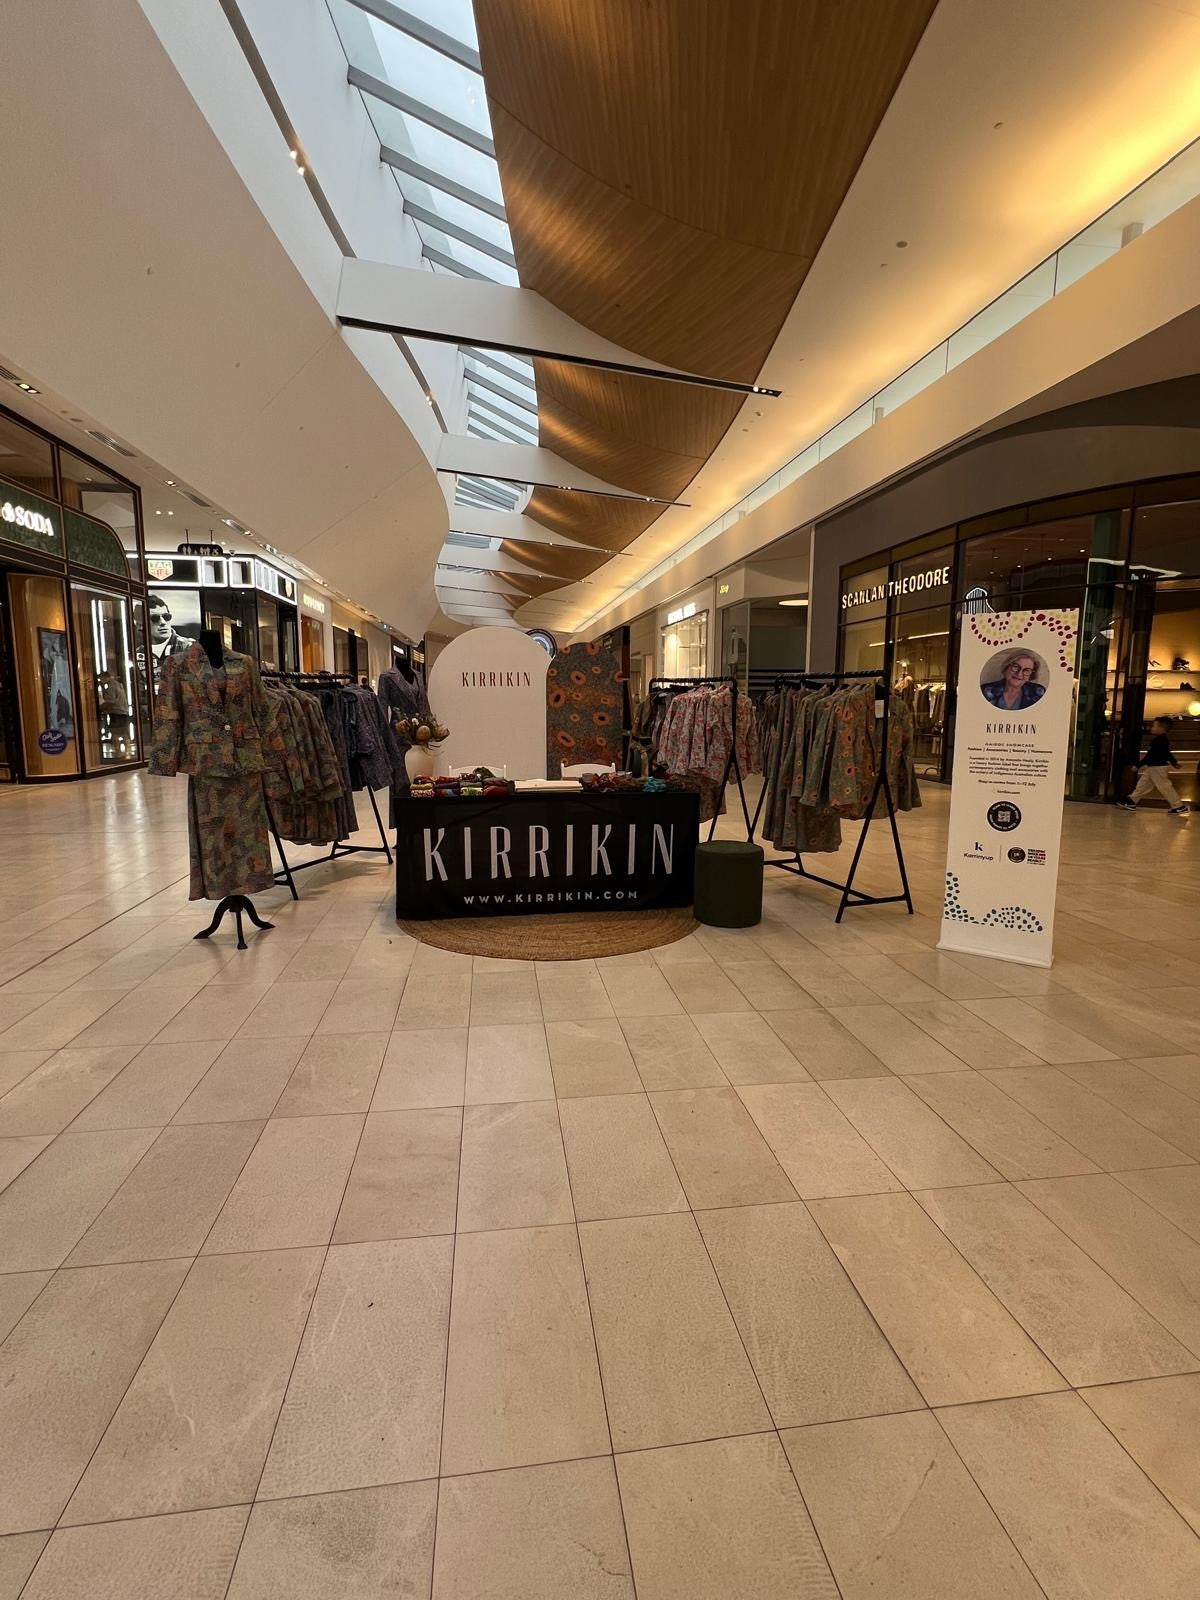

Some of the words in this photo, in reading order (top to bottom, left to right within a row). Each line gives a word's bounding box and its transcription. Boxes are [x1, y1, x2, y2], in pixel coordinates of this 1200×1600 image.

[841, 585, 885, 609] SCANLAN
[888, 566, 950, 597] THEODORE
[462, 671, 531, 687] KIRRIKIN
[986, 723, 1036, 734] KIRRIKIN
[423, 823, 673, 881] KIRRIKIN
[975, 842, 983, 851] k
[463, 890, 638, 905] WWW.KIRRIKIN.COM
